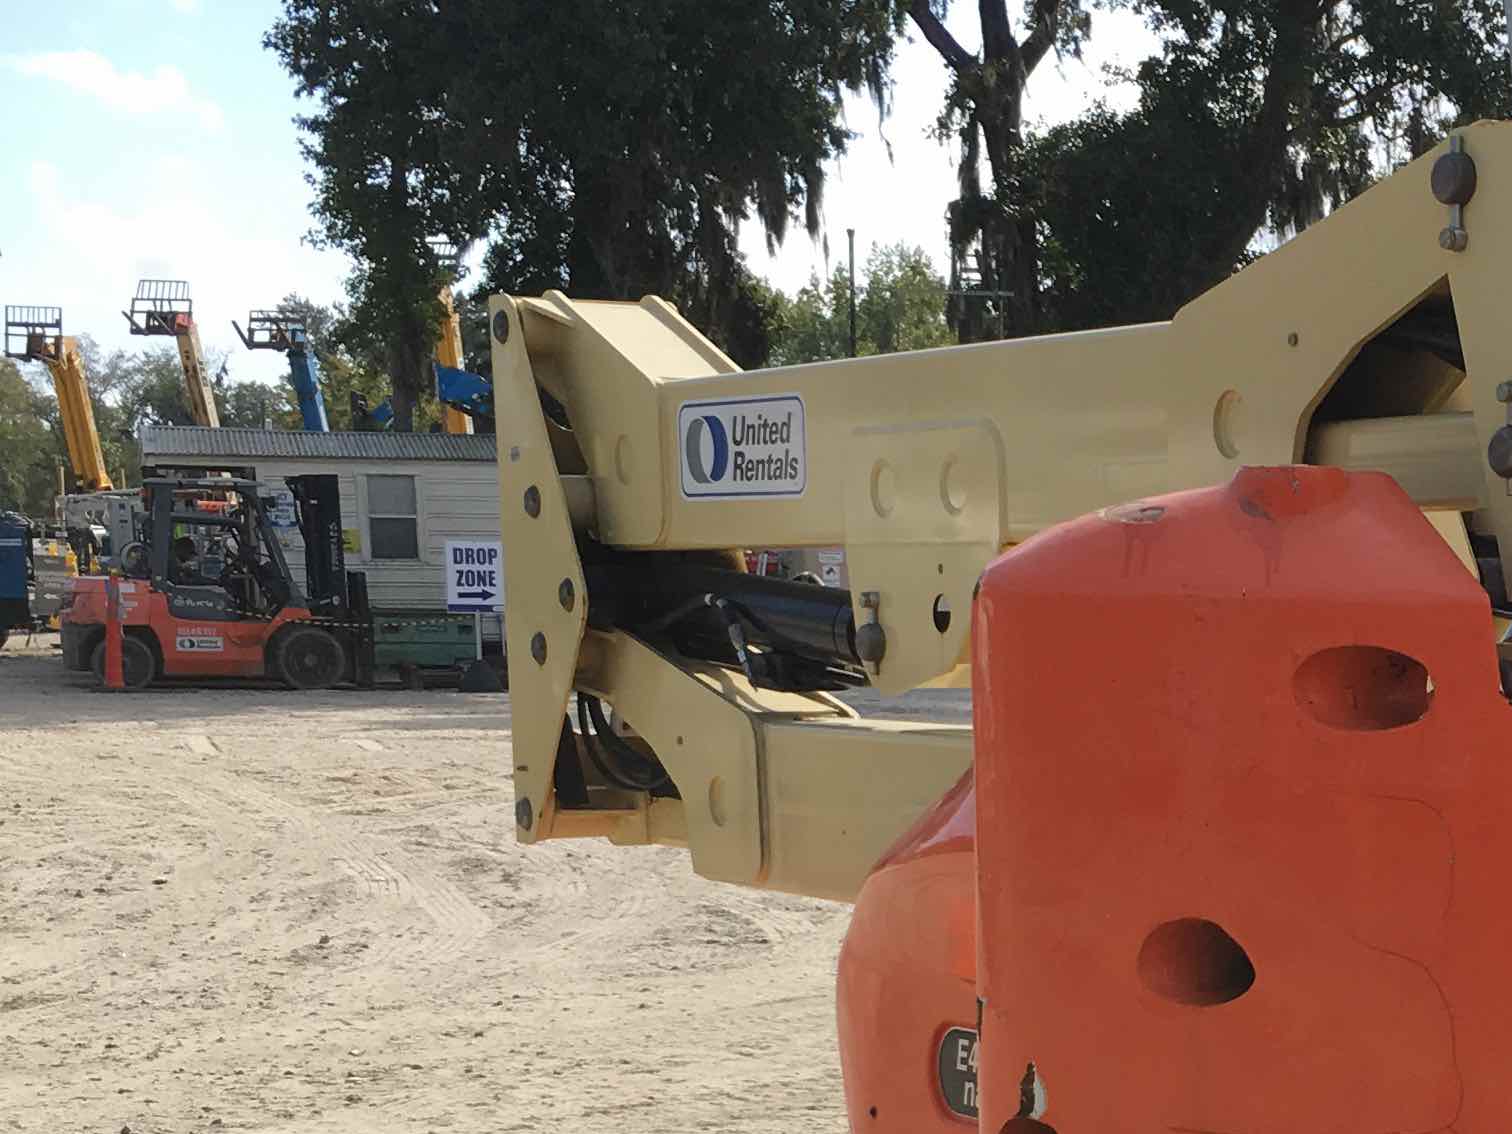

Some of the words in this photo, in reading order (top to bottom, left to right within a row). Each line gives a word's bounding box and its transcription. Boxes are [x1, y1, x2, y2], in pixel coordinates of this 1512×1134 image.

[732, 411, 791, 447] United
[733, 448, 799, 482] Rentals
[452, 547, 498, 566] DROP
[456, 569, 497, 588] ZONE
